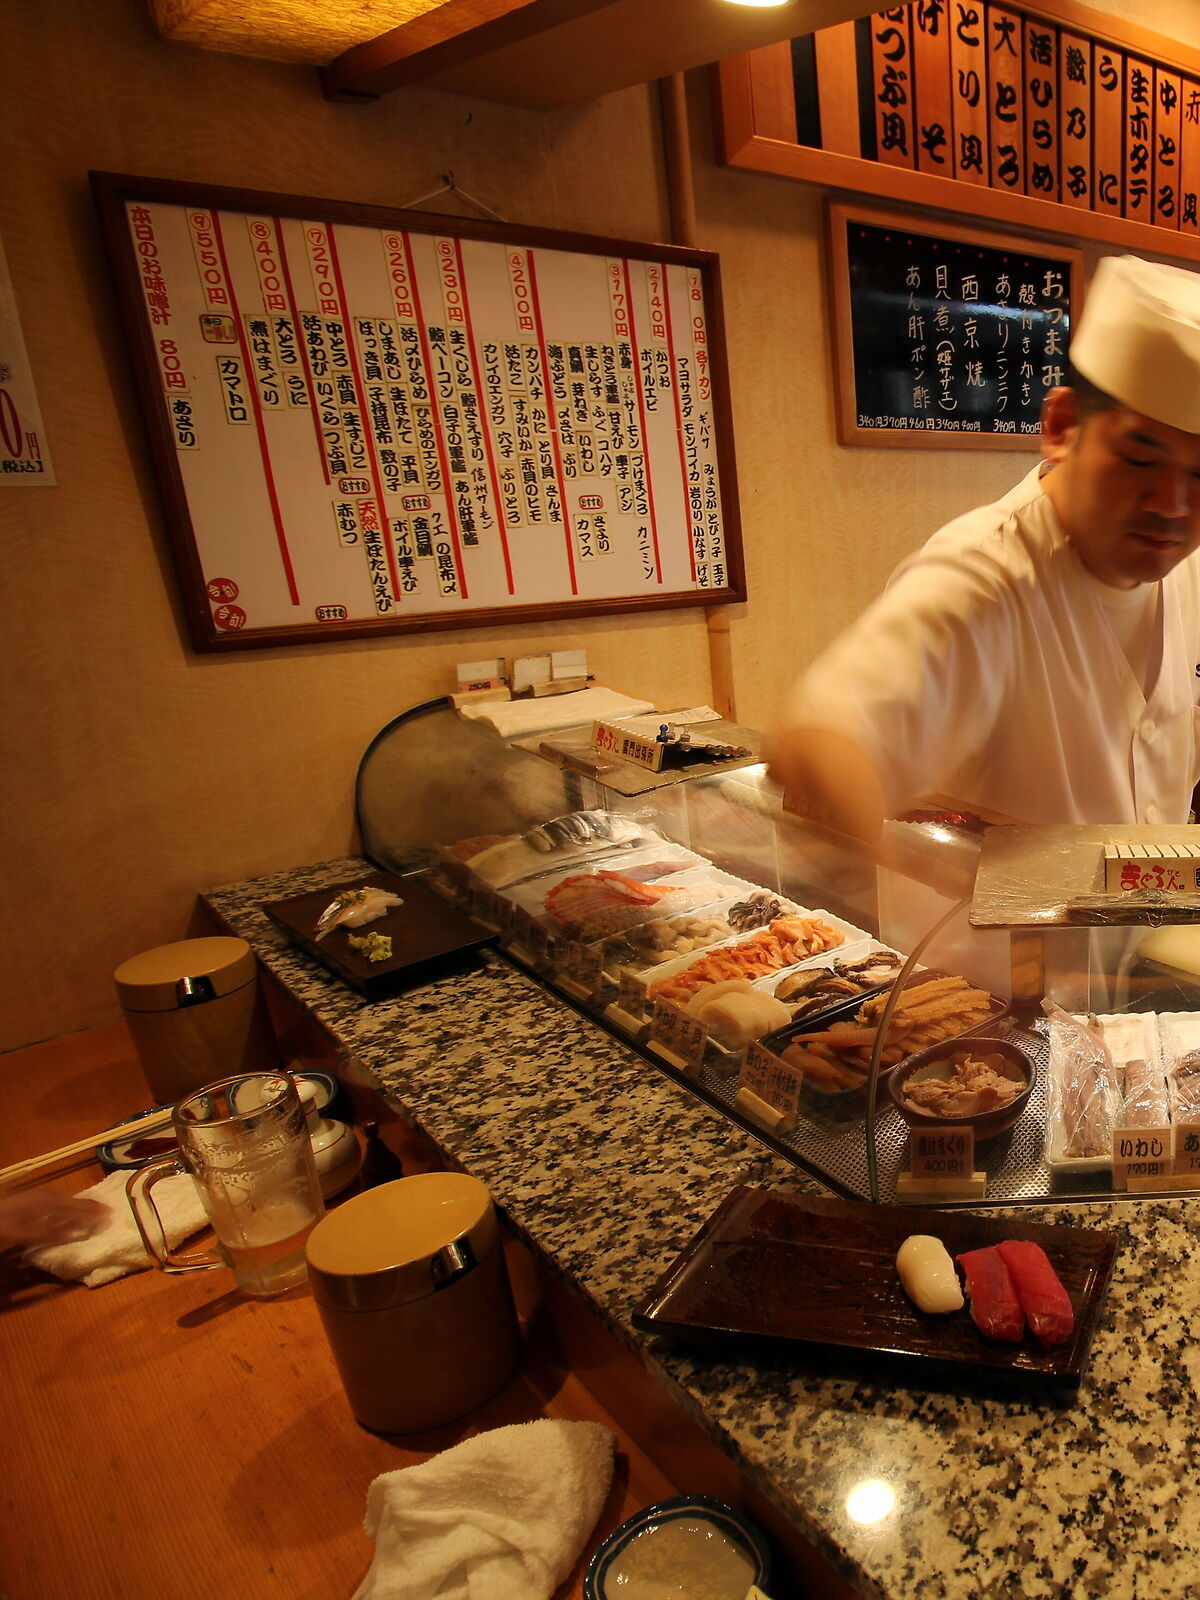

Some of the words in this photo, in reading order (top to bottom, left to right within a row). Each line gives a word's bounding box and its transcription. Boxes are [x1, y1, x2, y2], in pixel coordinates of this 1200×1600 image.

[956, 3, 983, 175] とり貝
[993, 16, 1020, 187] 大とろ
[1029, 28, 1054, 192] 活ひらめ
[1099, 55, 1118, 206] うに
[1129, 69, 1150, 208] 生ホタテ
[1157, 79, 1177, 218] 中とろ
[302, 315, 328, 377] 活あわび
[326, 323, 348, 367] 中とろ
[358, 321, 383, 382] ほっき貝
[378, 322, 401, 380] しまあじ
[450, 330, 473, 387] 生くじら
[961, 274, 986, 388] 西京焼
[221, 360, 247, 420] カマトロ
[250, 320, 279, 405] 煮はまぐり
[274, 318, 297, 364] 大とろ
[288, 375, 308, 406] うに
[336, 375, 357, 404] 赤貝
[483, 343, 506, 424] カレイのエンガワ
[505, 344, 523, 385] 活たこ
[585, 345, 602, 397] 生しらす
[656, 350, 670, 388] かつお
[677, 357, 693, 418] マヨサラダ
[173, 400, 196, 446] あさり
[317, 382, 339, 425] いくら
[368, 386, 394, 445] 子持昆布
[389, 386, 412, 444] 生ほたて
[513, 399, 532, 451] すみいか
[532, 408, 547, 434] かに
[548, 344, 567, 399] 海ぶどう
[562, 453, 577, 479] ぶり
[592, 406, 607, 431] ふぐ
[618, 343, 633, 369] 赤身
[631, 455, 648, 515] づけまぐろ
[324, 431, 348, 475] つぶ貝
[343, 412, 367, 469] 生すじこ
[416, 408, 441, 490] ひらめのエンガワ
[497, 431, 514, 458] 穴子
[538, 440, 555, 480] とり貝
[578, 435, 594, 473] いわし
[597, 441, 612, 477] コハダ
[608, 411, 624, 449] 甘えび
[619, 488, 632, 512] アジ
[683, 424, 700, 482] モンゴイカ
[380, 449, 401, 492] 数の子
[401, 455, 420, 484] 平貝
[500, 468, 521, 523] ぶりとろ
[521, 458, 542, 522] 赤貝のヒモ
[337, 503, 358, 544] 赤むつ
[545, 484, 563, 523] さんま
[689, 487, 703, 521] 岩のり
[577, 519, 594, 558] カマス
[712, 564, 726, 587] 玉子
[1121, 1138, 1163, 1157] いわし
